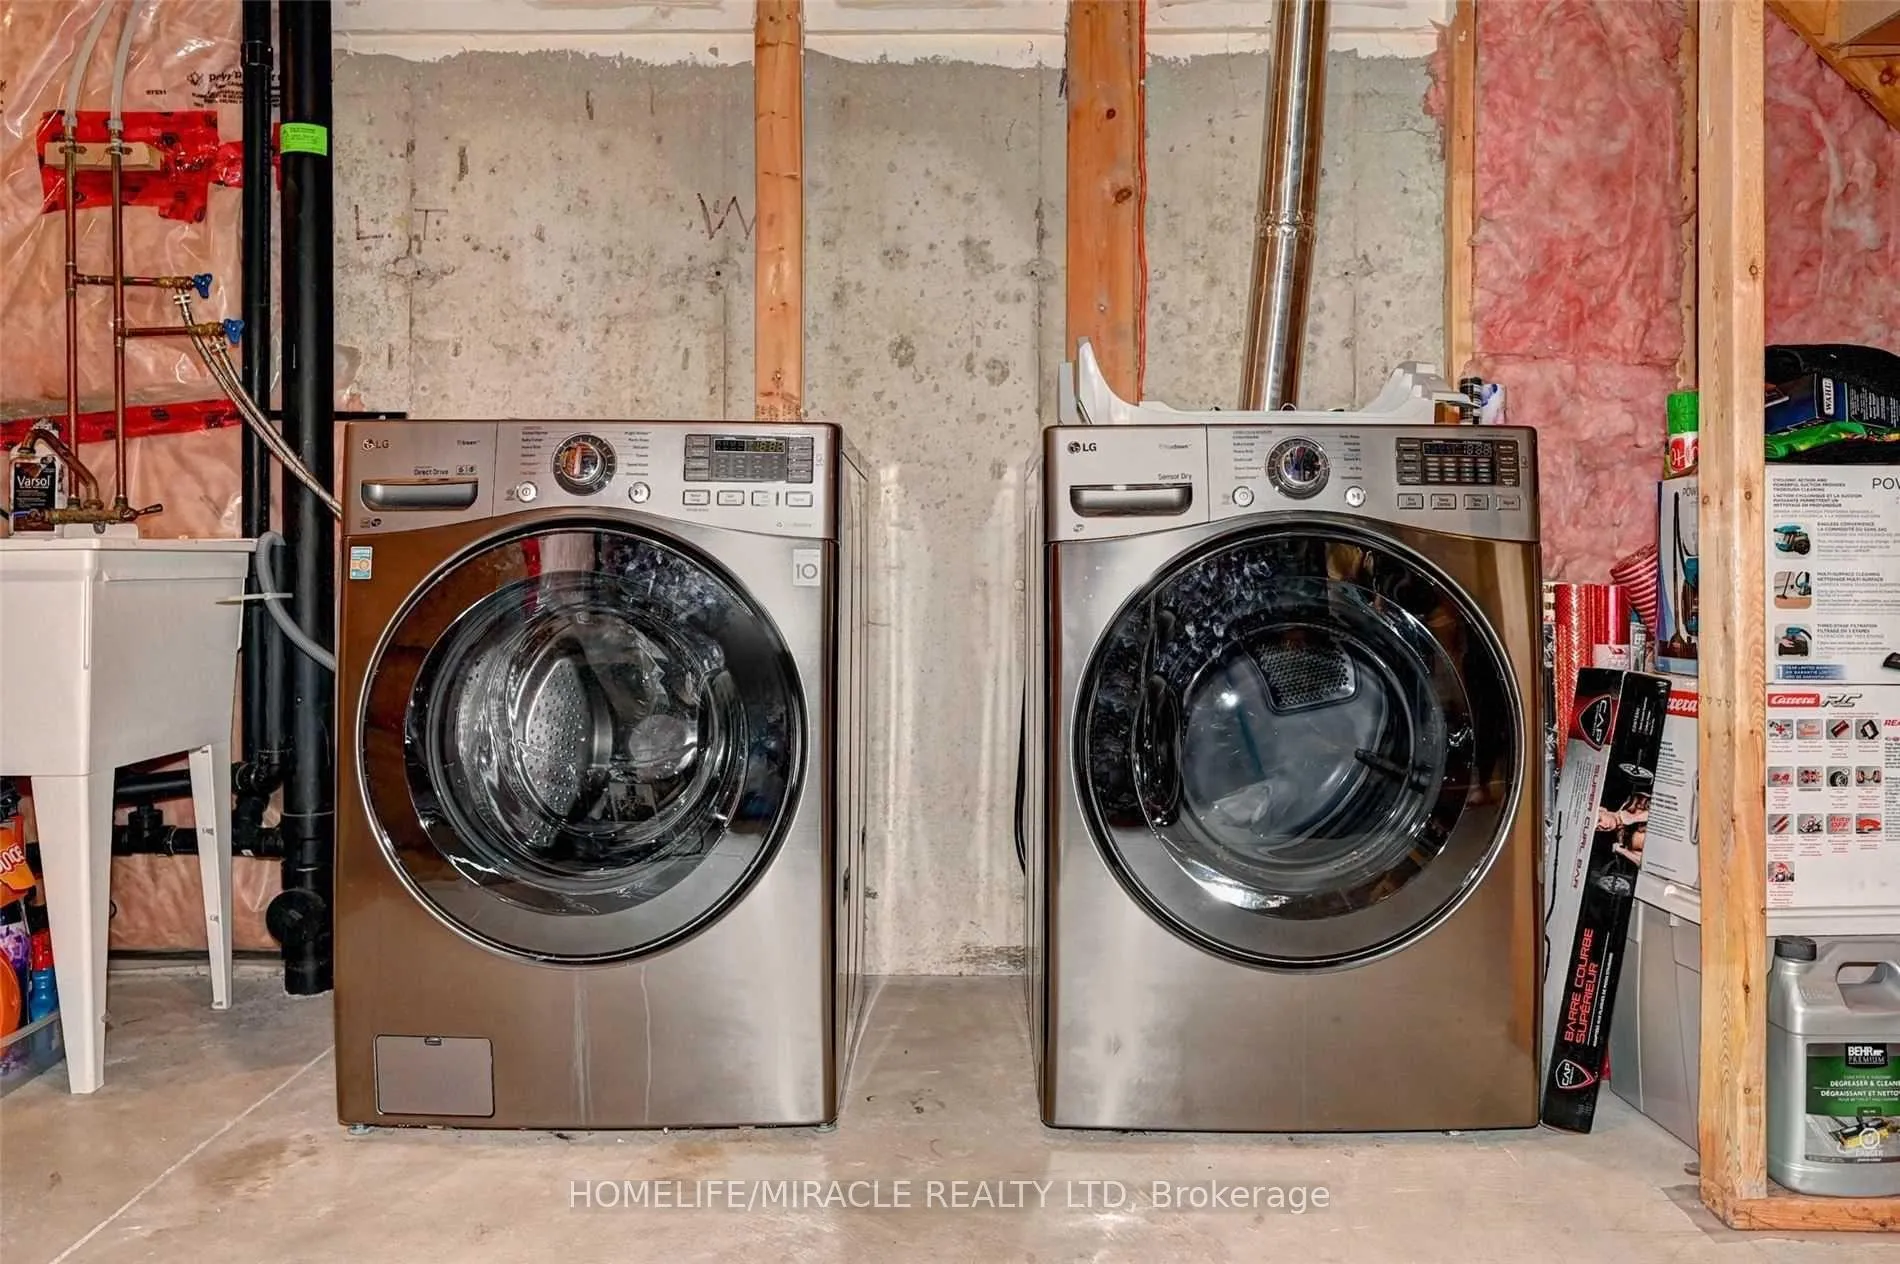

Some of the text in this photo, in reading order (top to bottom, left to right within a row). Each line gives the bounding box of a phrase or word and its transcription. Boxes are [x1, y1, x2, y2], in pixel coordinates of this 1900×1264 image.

[17, 475, 50, 486] Varsol
[1770, 694, 1817, 706] Carrera
[1597, 699, 1608, 742] CAP
[1588, 763, 1600, 812] SUPER
[1580, 817, 1591, 855] CURL
[1573, 859, 1583, 889] BAR
[1565, 928, 1594, 1042] BARRE COURBE
[1575, 963, 1599, 1044] SUPÉRIEUR
[1848, 1046, 1873, 1056] BEHR
[1562, 1063, 1571, 1086] CAP
